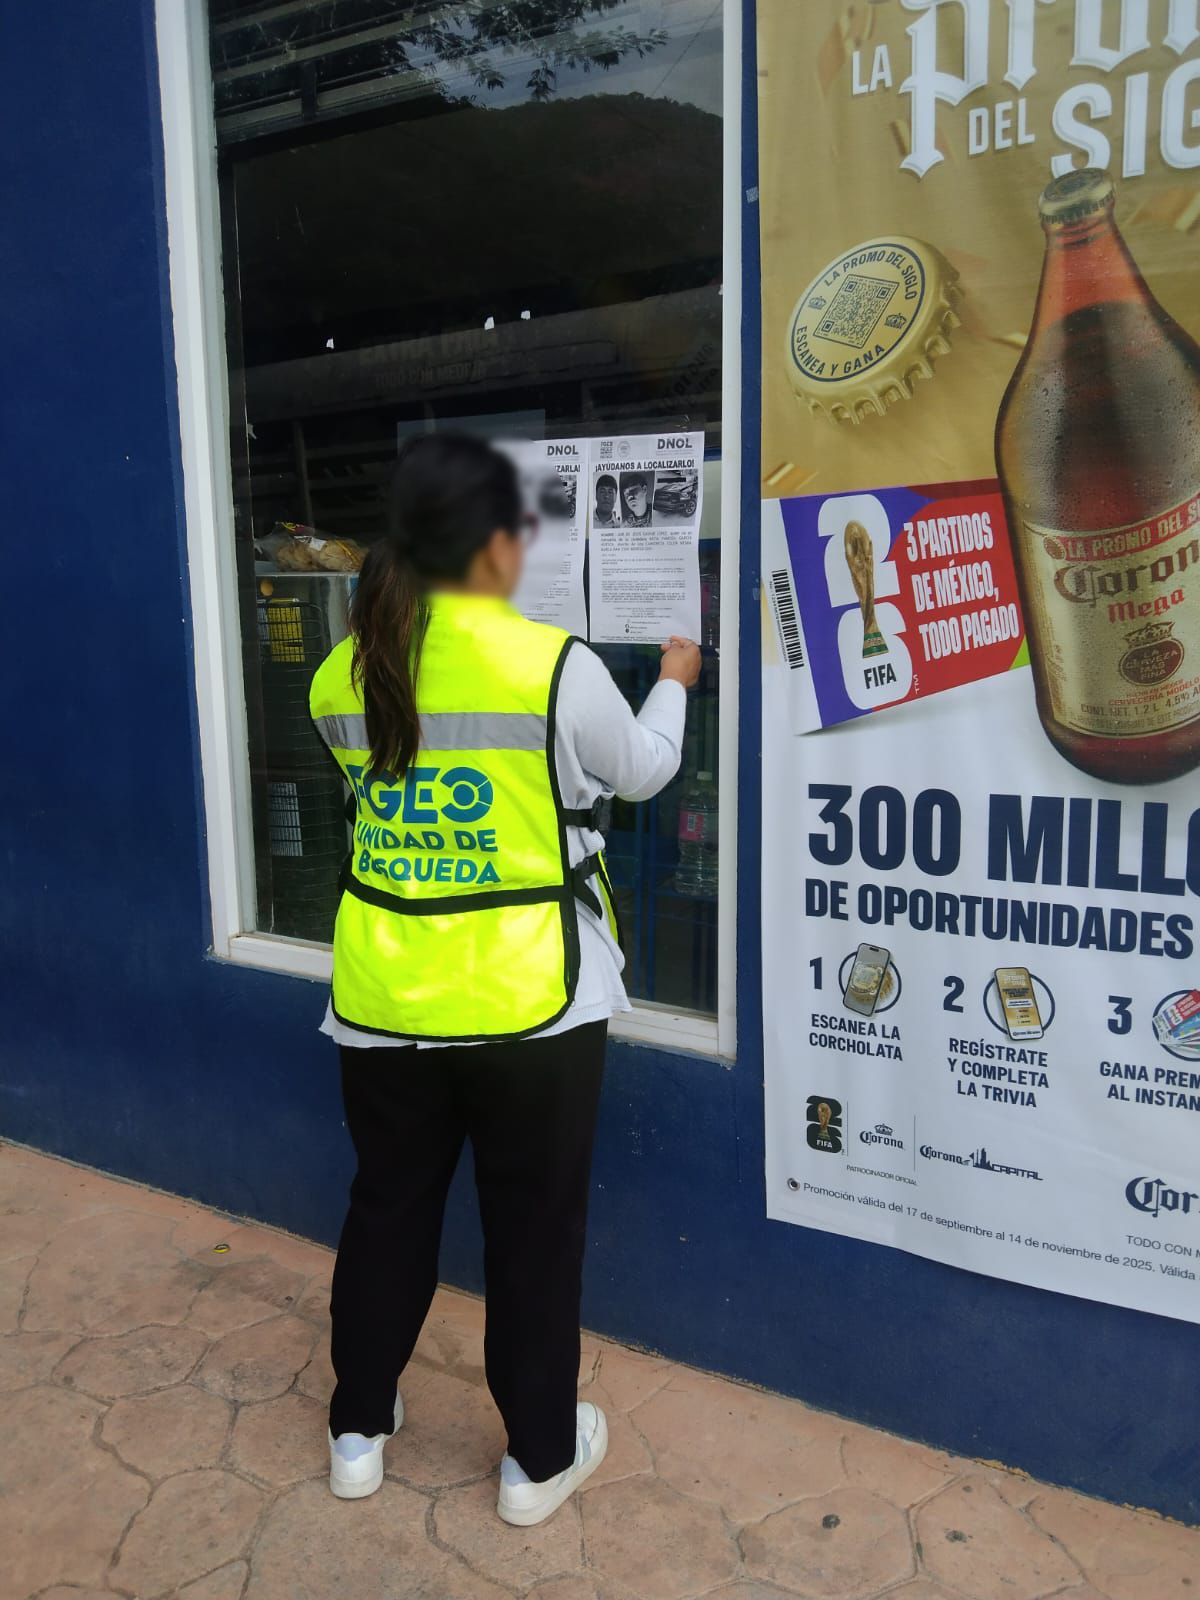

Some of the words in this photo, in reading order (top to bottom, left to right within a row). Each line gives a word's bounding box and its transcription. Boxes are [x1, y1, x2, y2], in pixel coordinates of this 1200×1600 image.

[852, 44, 893, 95] LA
[968, 97, 1036, 156] DEL
[824, 271, 840, 287] LA
[842, 250, 887, 273] PROMO
[885, 251, 906, 270] DEL
[901, 264, 919, 301] SIGLO
[796, 325, 826, 376] ESCANEA
[830, 363, 839, 376] Y
[843, 344, 885, 374] GANA
[547, 444, 579, 456] DNOL
[656, 437, 693, 450] DNOL
[636, 461, 642, 470] A
[643, 459, 695, 471] LOCALIZARLO!
[904, 522, 919, 562] 3
[917, 511, 994, 560] PARTIDOS
[1068, 540, 1086, 558] LA
[1091, 527, 1151, 556] PROMO
[1157, 511, 1183, 537] DEL
[911, 571, 935, 613] DE
[933, 559, 999, 609] MÉXICO,
[1107, 588, 1185, 624] Mega
[918, 617, 961, 662] TODO
[960, 603, 1019, 651] PAGADO
[863, 662, 897, 689] FIFA
[357, 820, 445, 850] UNIDAD
[453, 828, 499, 853] DE
[808, 783, 962, 877] 300
[805, 878, 849, 921] DE
[857, 883, 1194, 960] OPORTUNIDADES
[809, 957, 823, 990] 1
[943, 975, 965, 1013] 2
[810, 1013, 878, 1037] ESCANEA
[882, 1024, 901, 1041] LA
[1107, 995, 1133, 1035] 3
[809, 1032, 903, 1062] CORCHOLATA
[948, 1037, 1048, 1068] REGÍSTRATE
[947, 1057, 957, 1073] Y
[961, 1060, 1049, 1089] COMPLETA
[1099, 1060, 1149, 1082] GANA
[957, 1080, 977, 1097] LA
[982, 1085, 1037, 1108] TRIVIA
[1107, 1083, 1130, 1101] AL
[816, 1139, 833, 1148] FIFA
[859, 1130, 904, 1149] Corona
[846, 1164, 895, 1180] PATROCINADOR
[894, 1175, 918, 1186] OFICIAL
[919, 1144, 963, 1164] Corona
[991, 1162, 1044, 1181] CAPITAL
[803, 1182, 855, 1203] Promoción
[857, 1196, 886, 1210] válida
[888, 1202, 904, 1214] del
[906, 1207, 918, 1217] 17
[920, 1210, 934, 1222] de
[935, 1216, 993, 1238] septiembre
[995, 1231, 1005, 1241] al
[1009, 1233, 1022, 1245] 14
[1024, 1237, 1039, 1248] de
[1042, 1240, 1102, 1261] noviembre
[1104, 1252, 1120, 1265] de
[1122, 1256, 1156, 1273] 2025.
[1159, 1263, 1196, 1281] Válida
[1126, 1234, 1162, 1250] TODO
[1163, 1243, 1192, 1257] CON
